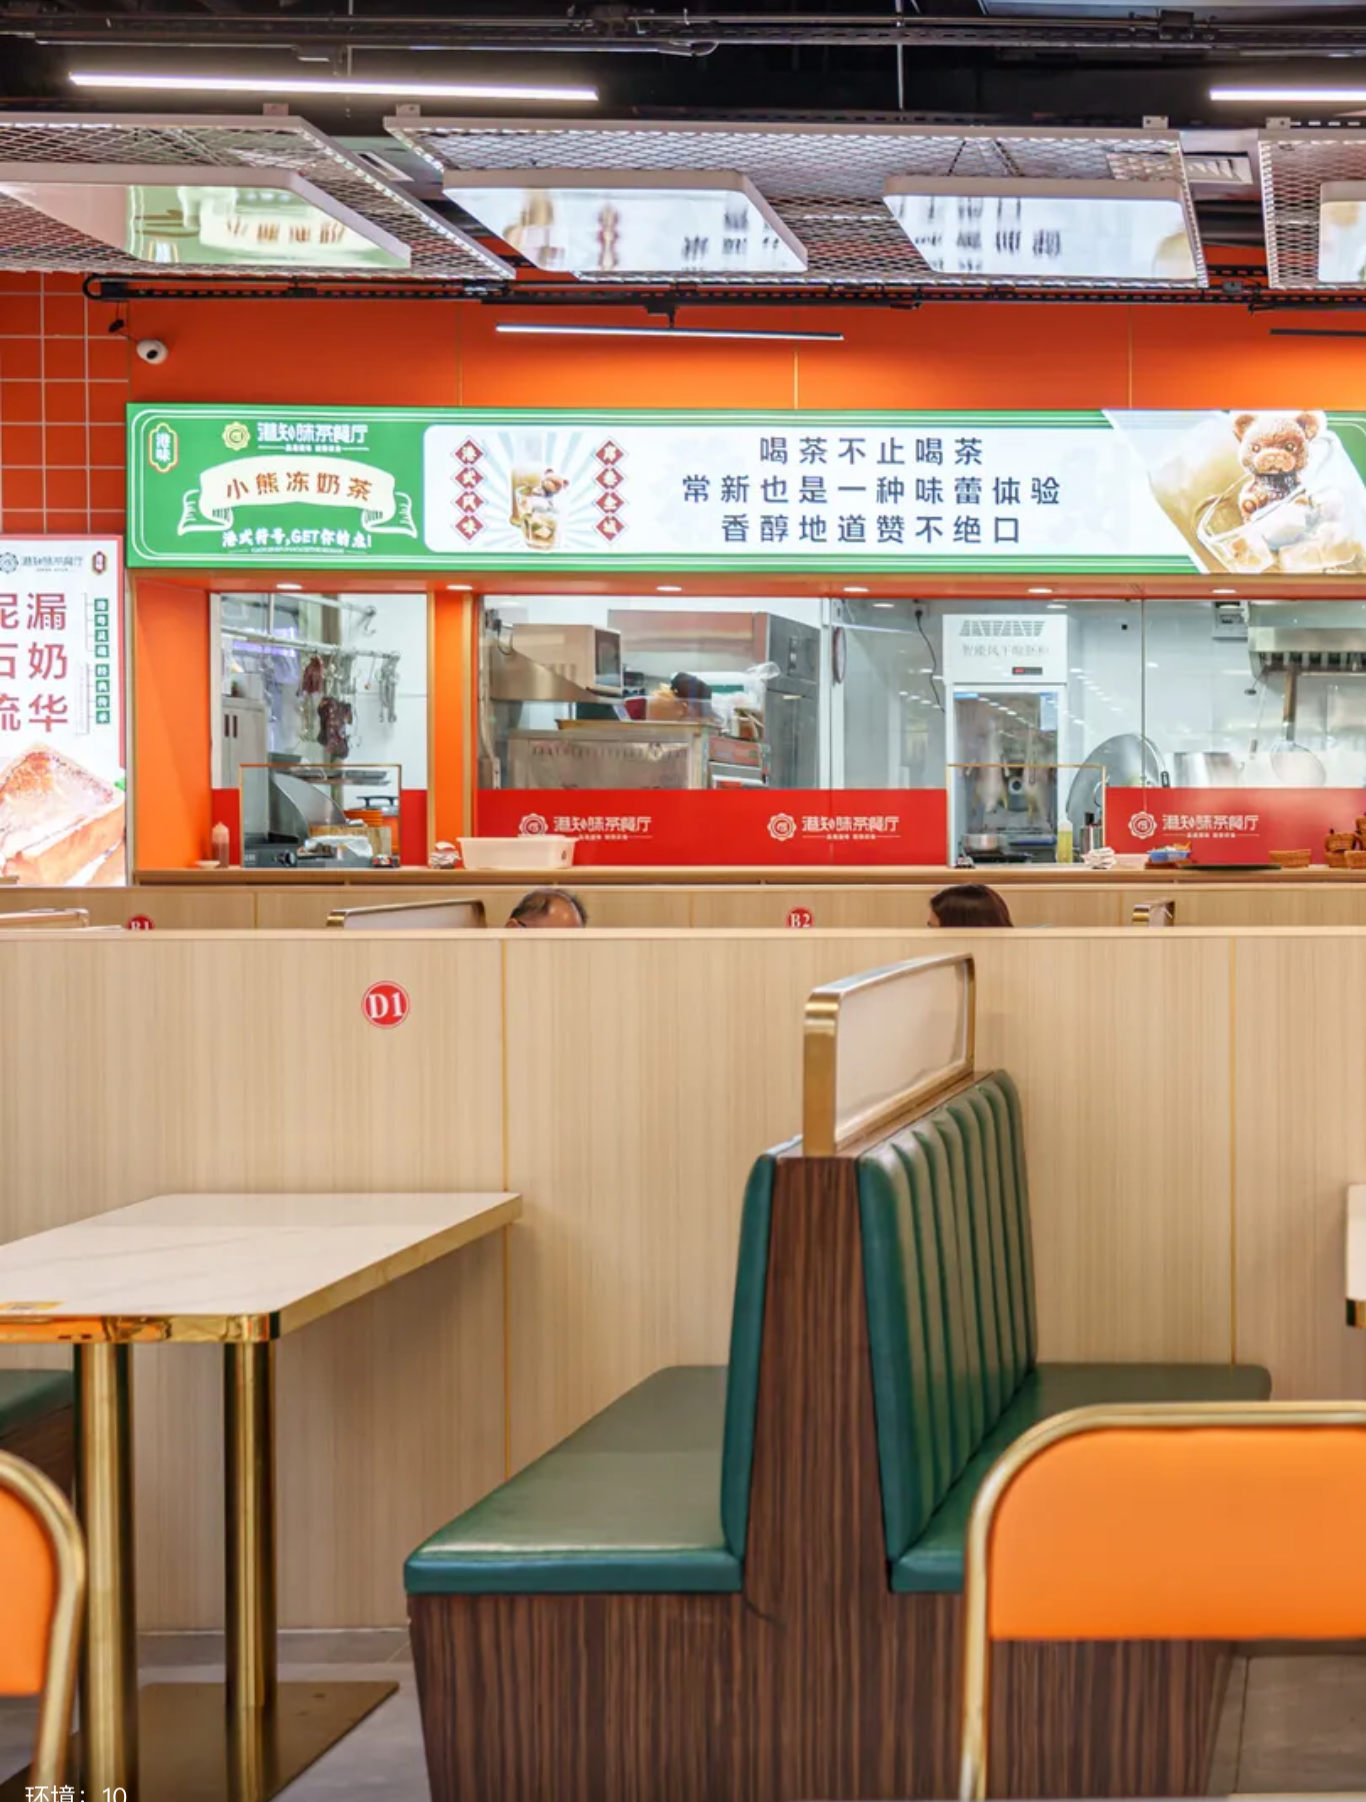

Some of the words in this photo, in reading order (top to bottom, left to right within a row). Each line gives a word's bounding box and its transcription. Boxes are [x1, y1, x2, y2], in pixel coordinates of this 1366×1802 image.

[759, 437, 983, 466] 喝茶不止喝茶
[226, 471, 373, 501] 小熊冻奶茶
[682, 474, 1061, 505] 常新也是一种味蕾体验
[721, 513, 1020, 544] 香醇地道赞不绝口
[27, 592, 68, 733] 漏奶华
[553, 816, 652, 832] 港知味茶餐厅
[802, 816, 900, 832] 港知味茶餐厅
[1162, 815, 1259, 831] 港知味茶餐厅
[791, 913, 810, 928] B2
[369, 992, 403, 1019] D1
